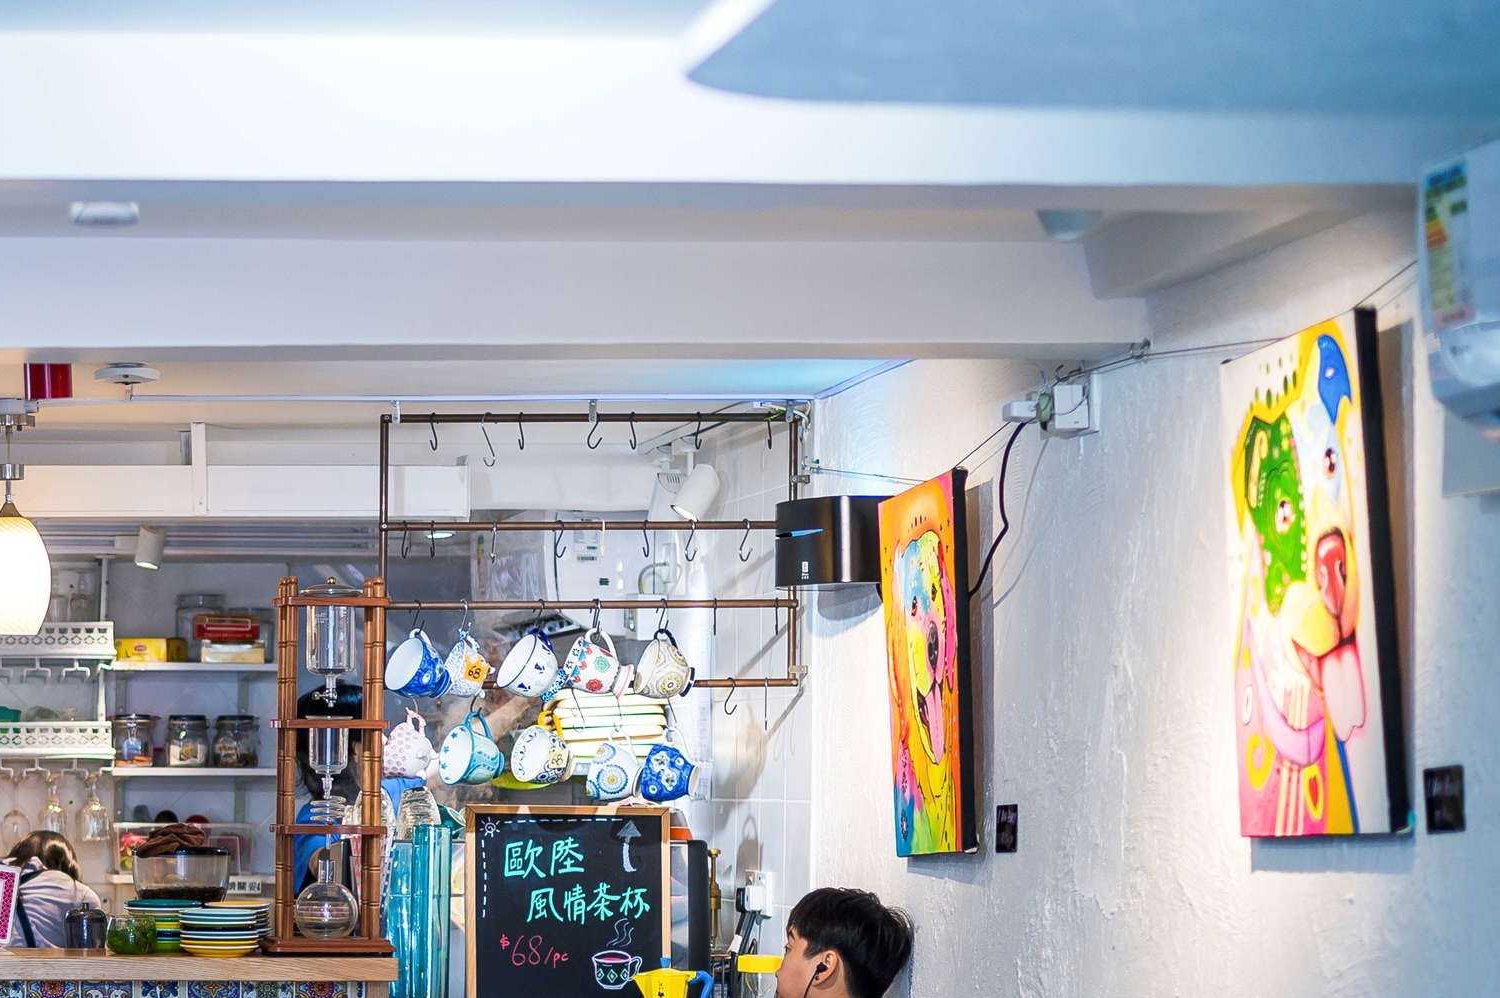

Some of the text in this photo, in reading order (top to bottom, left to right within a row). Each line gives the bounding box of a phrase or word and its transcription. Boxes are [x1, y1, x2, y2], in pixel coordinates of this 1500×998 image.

[503, 836, 586, 880] 歐陸
[526, 881, 651, 926] 風情茶杯
[499, 933, 570, 969] $68/pc
